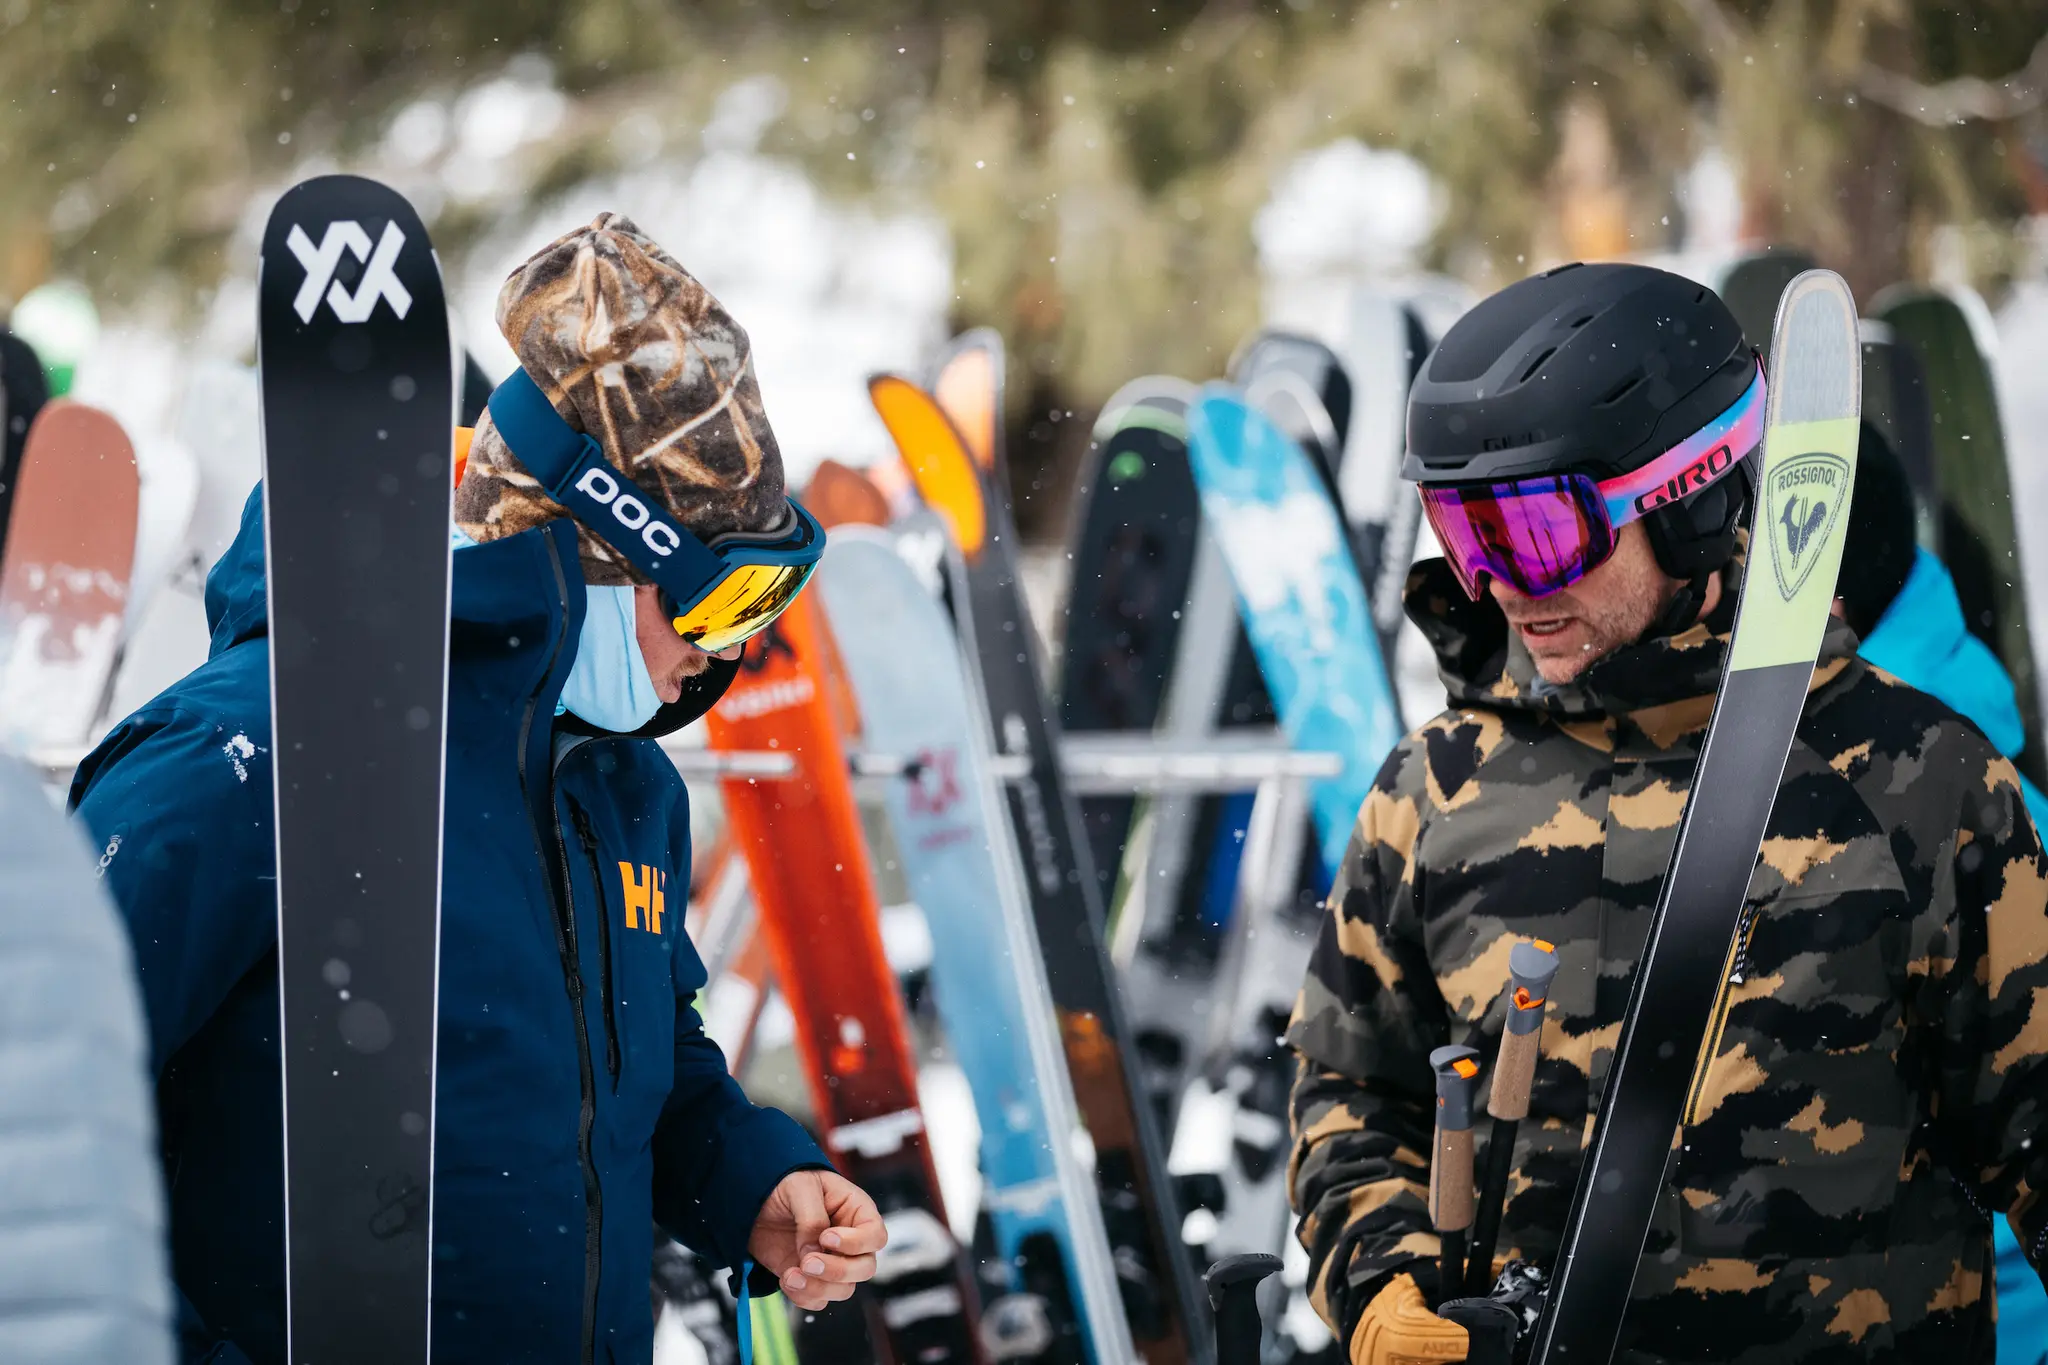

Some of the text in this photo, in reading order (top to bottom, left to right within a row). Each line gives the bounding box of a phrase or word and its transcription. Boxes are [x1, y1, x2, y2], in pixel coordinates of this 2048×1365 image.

[575, 467, 681, 556] POC
[1634, 445, 1733, 514] GIRO
[1778, 466, 1837, 492] ROSSIGNOL
